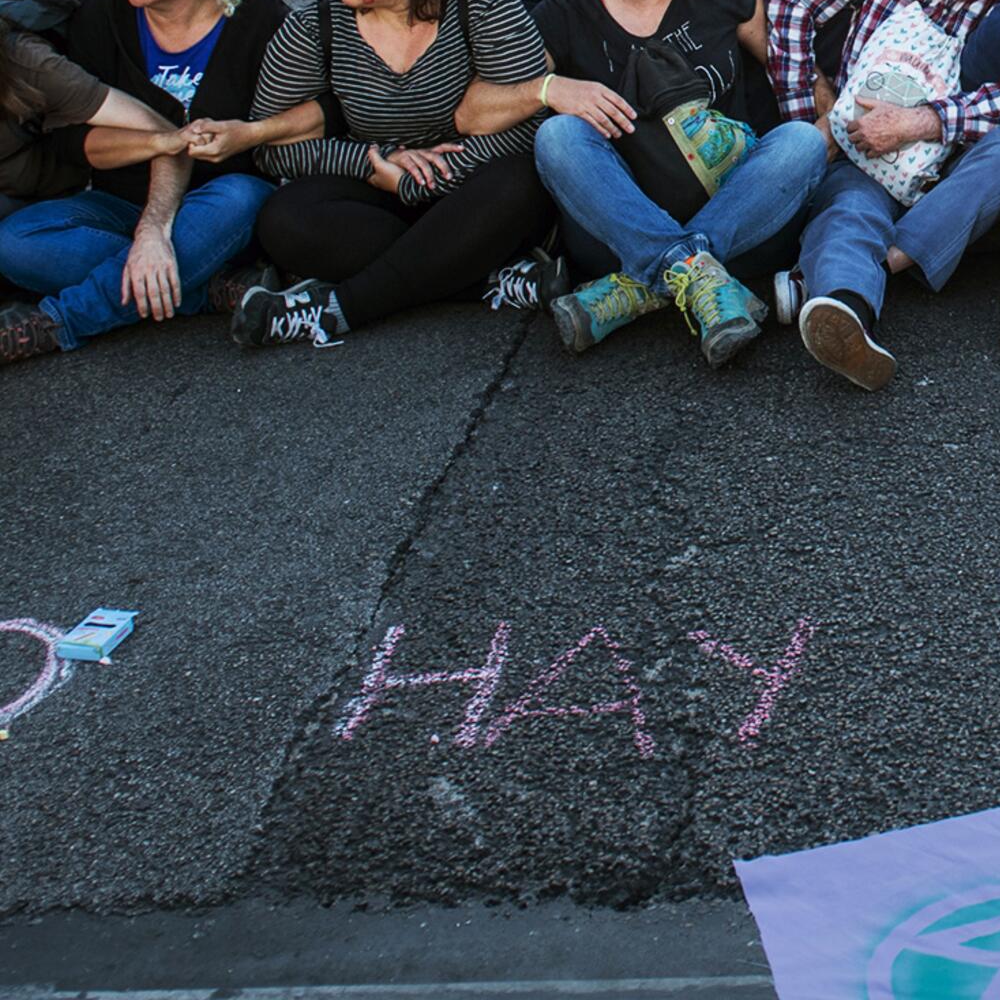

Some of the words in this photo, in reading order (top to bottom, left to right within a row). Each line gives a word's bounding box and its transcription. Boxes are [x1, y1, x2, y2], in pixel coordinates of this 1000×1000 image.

[662, 20, 703, 52] THE
[158, 65, 204, 88] Take
[333, 615, 815, 760] HAY
